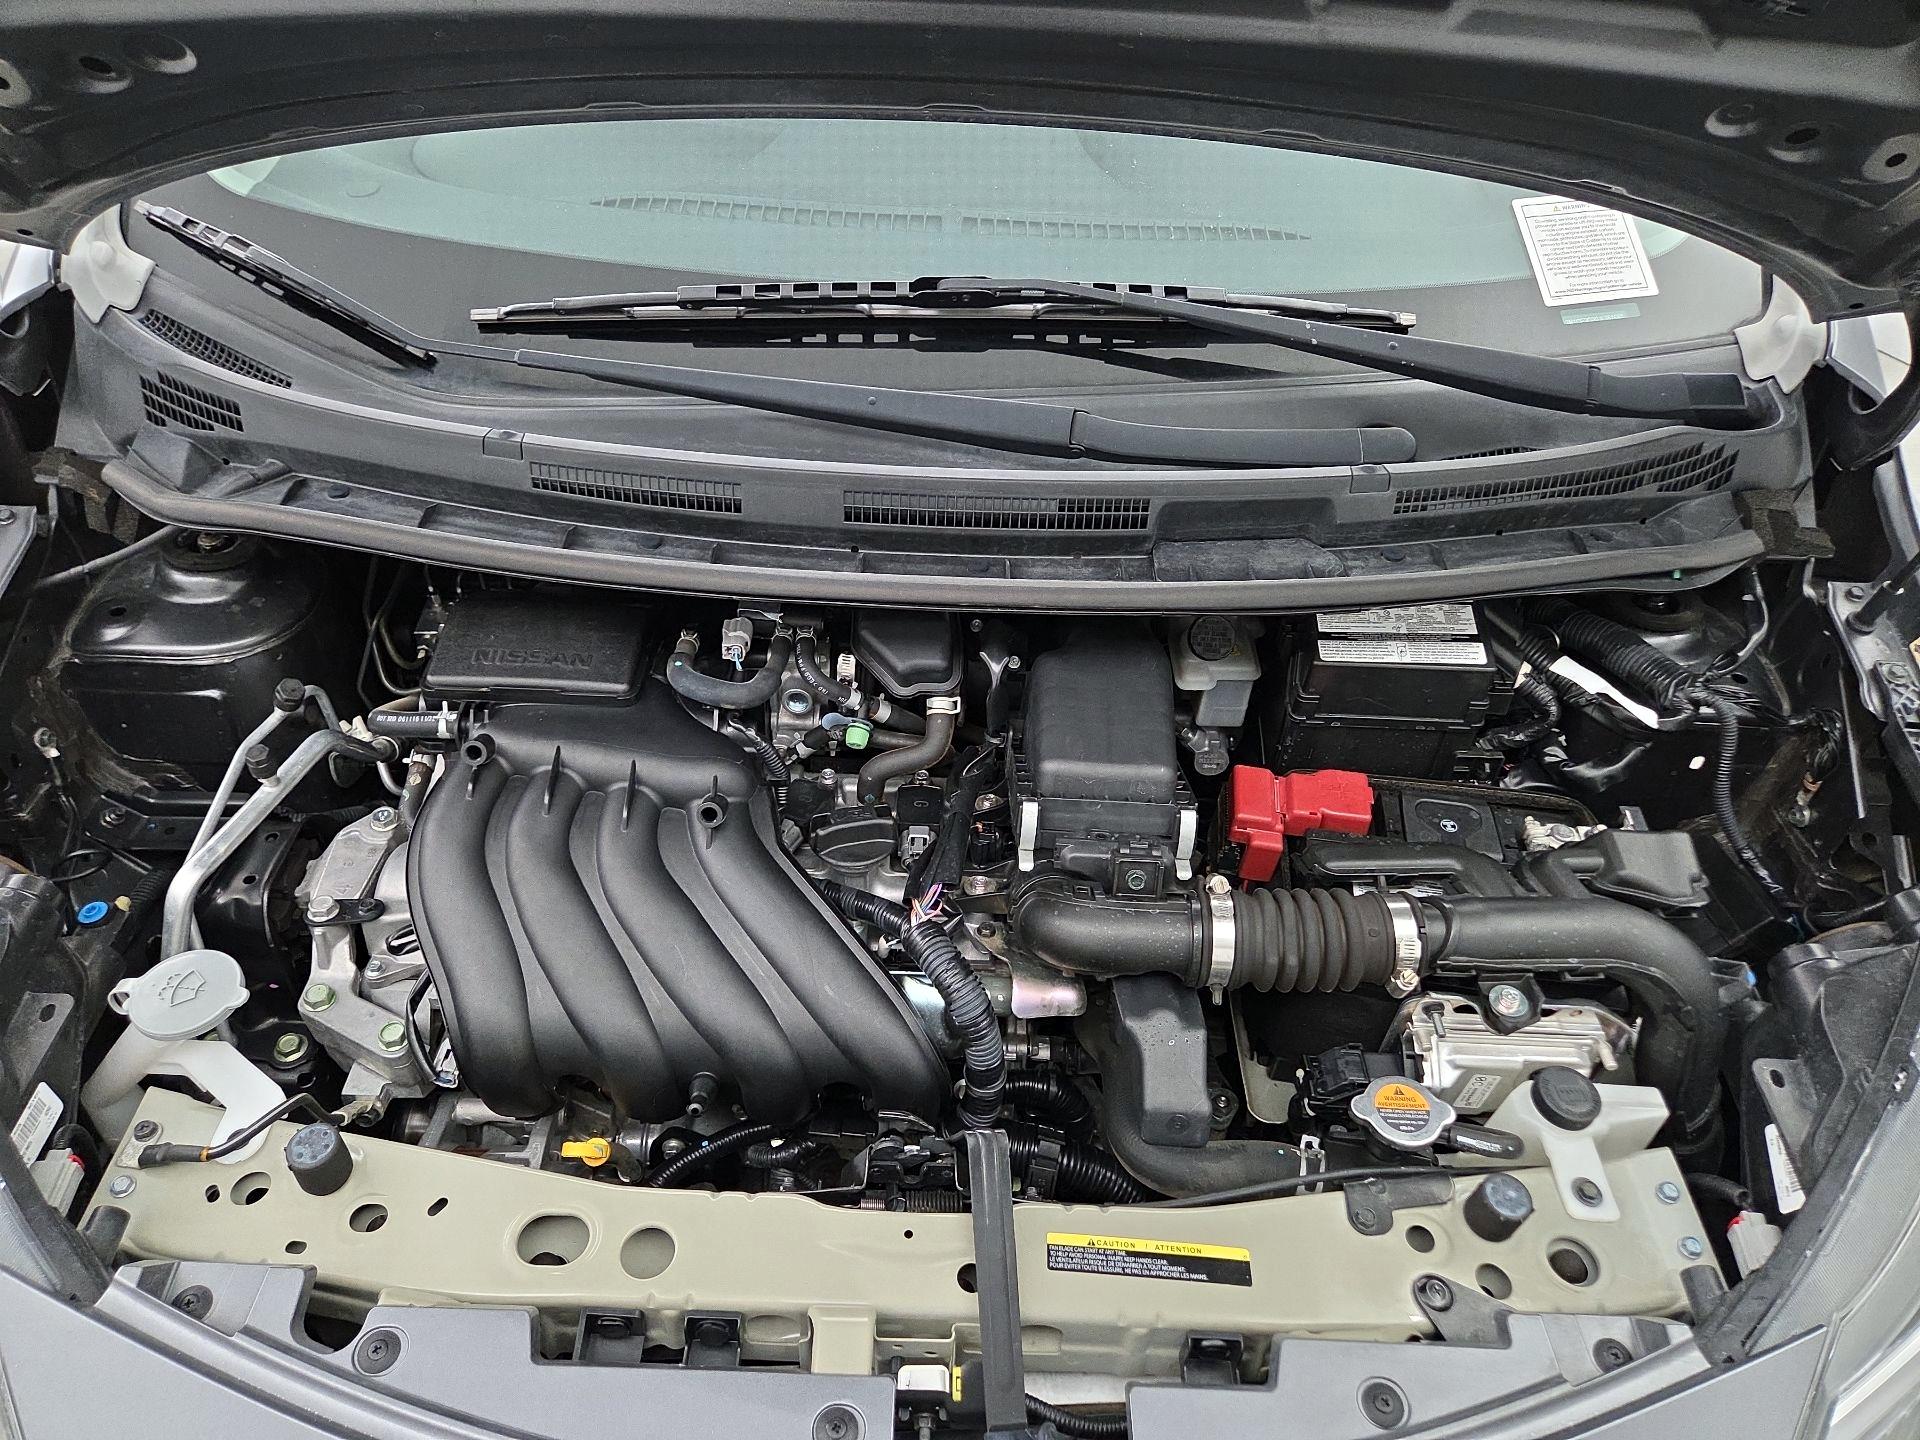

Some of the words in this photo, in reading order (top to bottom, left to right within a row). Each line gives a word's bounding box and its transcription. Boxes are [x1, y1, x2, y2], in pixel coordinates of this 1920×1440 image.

[470, 648, 594, 668] NISSAN
[1096, 1239, 1136, 1249] CAUTION
[1154, 1244, 1202, 1255] ATTENTION
[1149, 1268, 1180, 1277] APPROCHER
